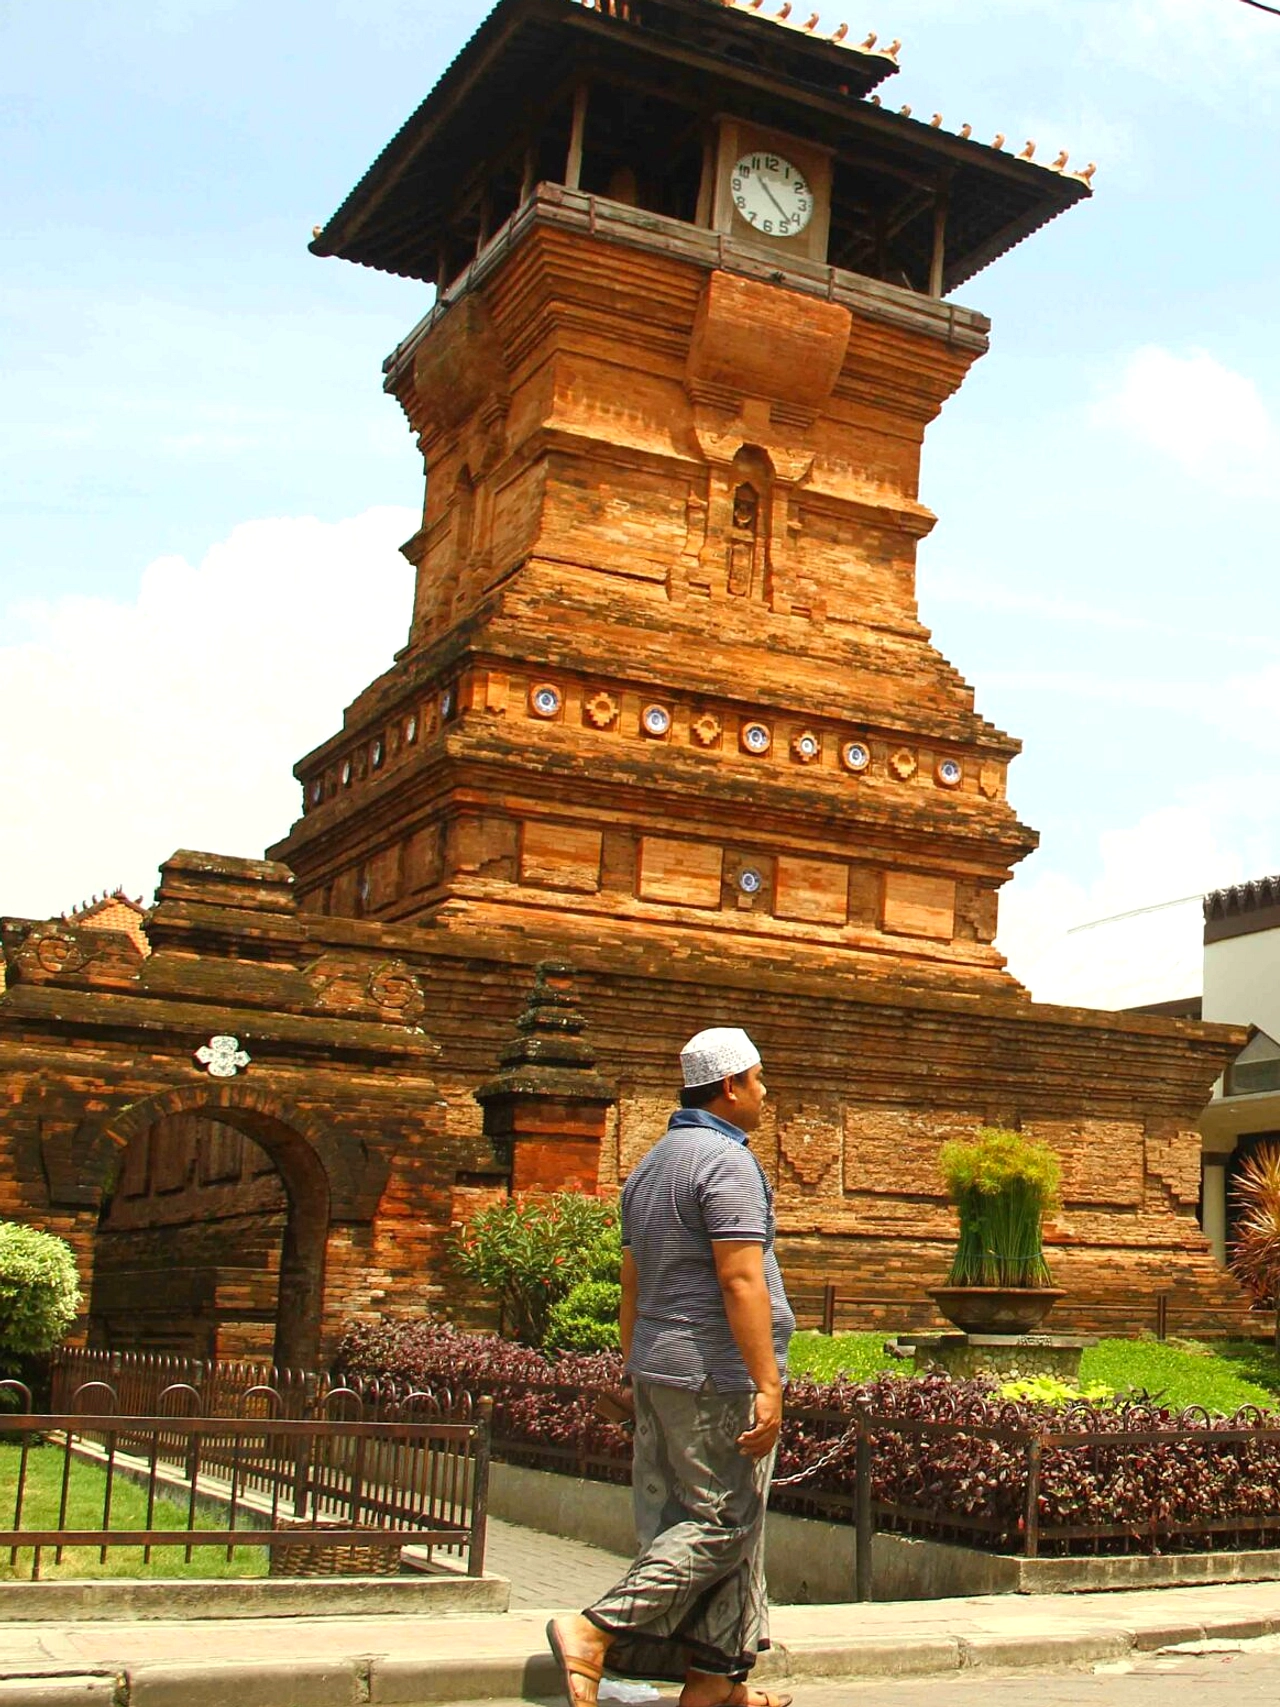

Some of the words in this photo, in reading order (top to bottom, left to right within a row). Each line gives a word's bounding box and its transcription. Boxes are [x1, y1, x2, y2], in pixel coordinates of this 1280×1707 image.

[752, 156, 761, 170] 11
[765, 156, 779, 172] 12
[739, 164, 750, 179] 10
[785, 167, 790, 179] 1
[732, 178, 741, 192] 9
[794, 182, 804, 194] 2
[736, 196, 746, 209] 8
[798, 199, 807, 212] 3
[748, 212, 757, 223] 7
[791, 213, 801, 226] 4
[763, 220, 773, 233] 6
[779, 221, 789, 234] 5
